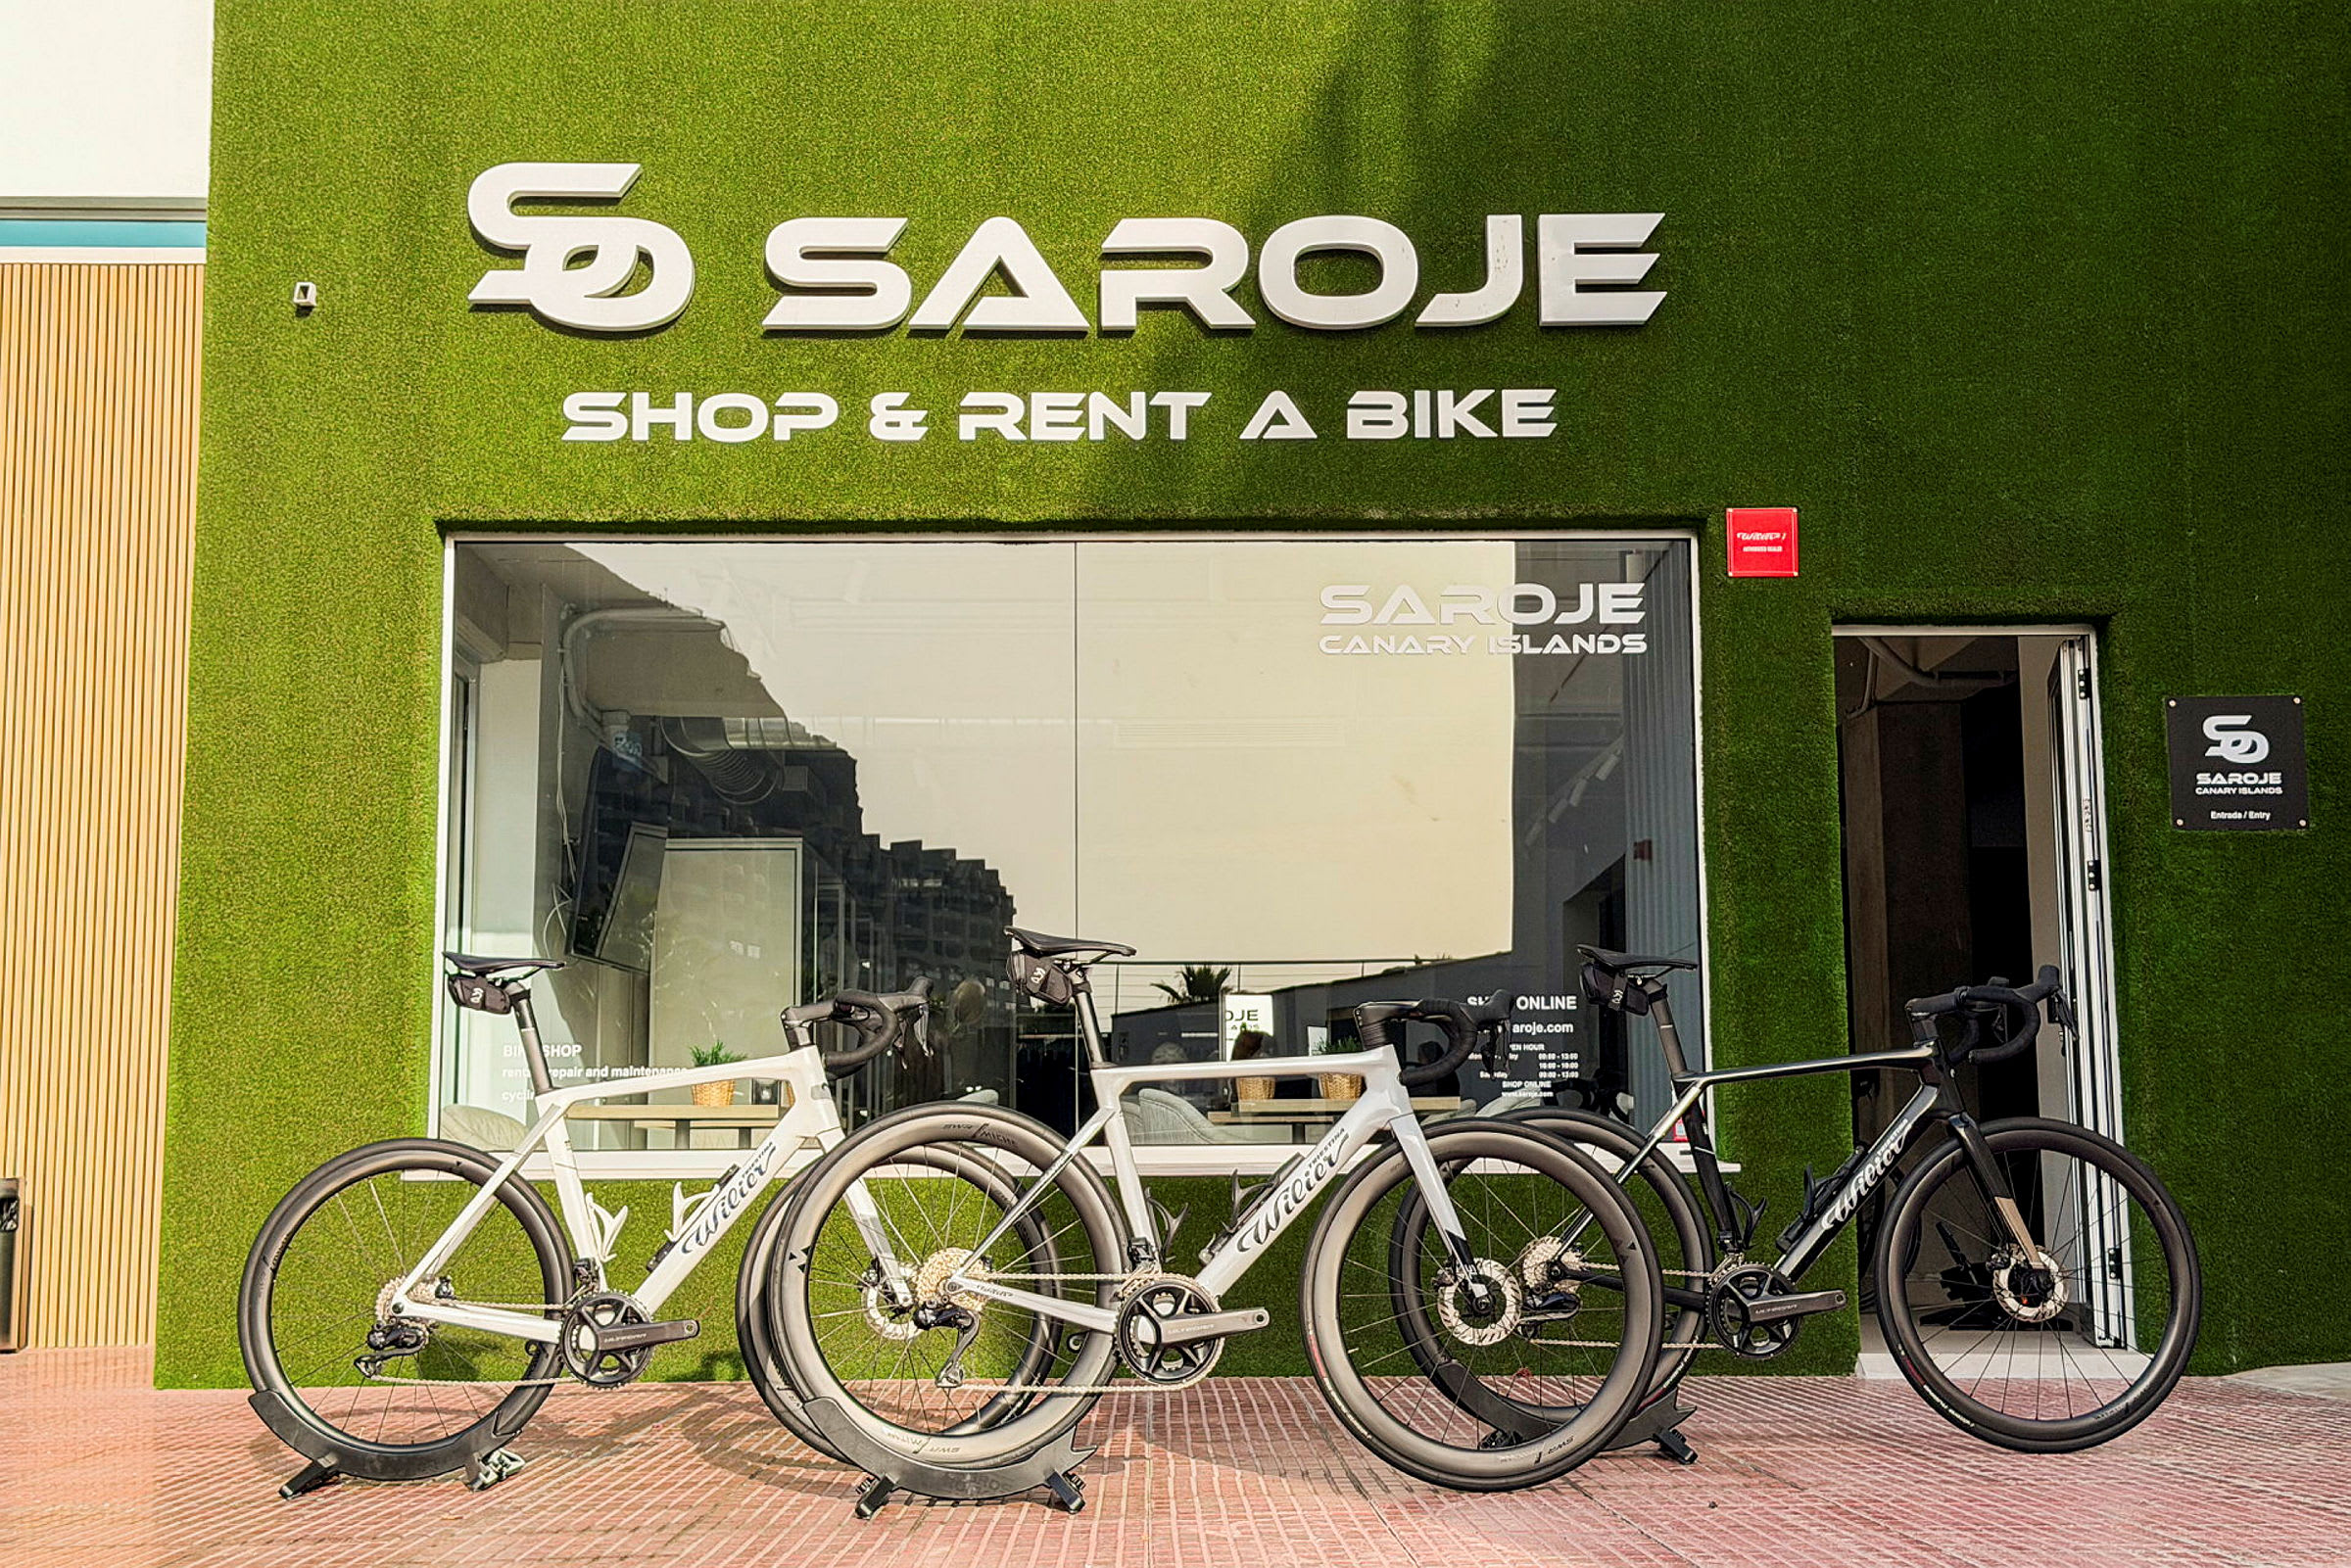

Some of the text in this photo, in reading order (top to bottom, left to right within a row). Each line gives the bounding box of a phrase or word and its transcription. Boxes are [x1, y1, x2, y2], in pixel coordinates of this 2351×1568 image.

[762, 212, 1667, 333] SAROJE
[561, 388, 1559, 443] SHOP & RENT A BIKE
[1319, 582, 1647, 626] SAROJE
[1319, 634, 1648, 655] CANARY ISLANDS
[2196, 772, 2282, 784] SAROJE
[2195, 786, 2283, 795] CANARY ISLANDS
[2210, 810, 2243, 820] Entrada
[2248, 810, 2271, 822] Entry
[1515, 995, 1578, 1011] ONLINE
[1511, 1022, 1574, 1036] aroje.com
[542, 1044, 582, 1058] SHOP
[586, 1066, 609, 1077] and
[1822, 1123, 1911, 1230] Wilier
[681, 1145, 777, 1255] Wilier
[1236, 1132, 1350, 1253] Wilier
